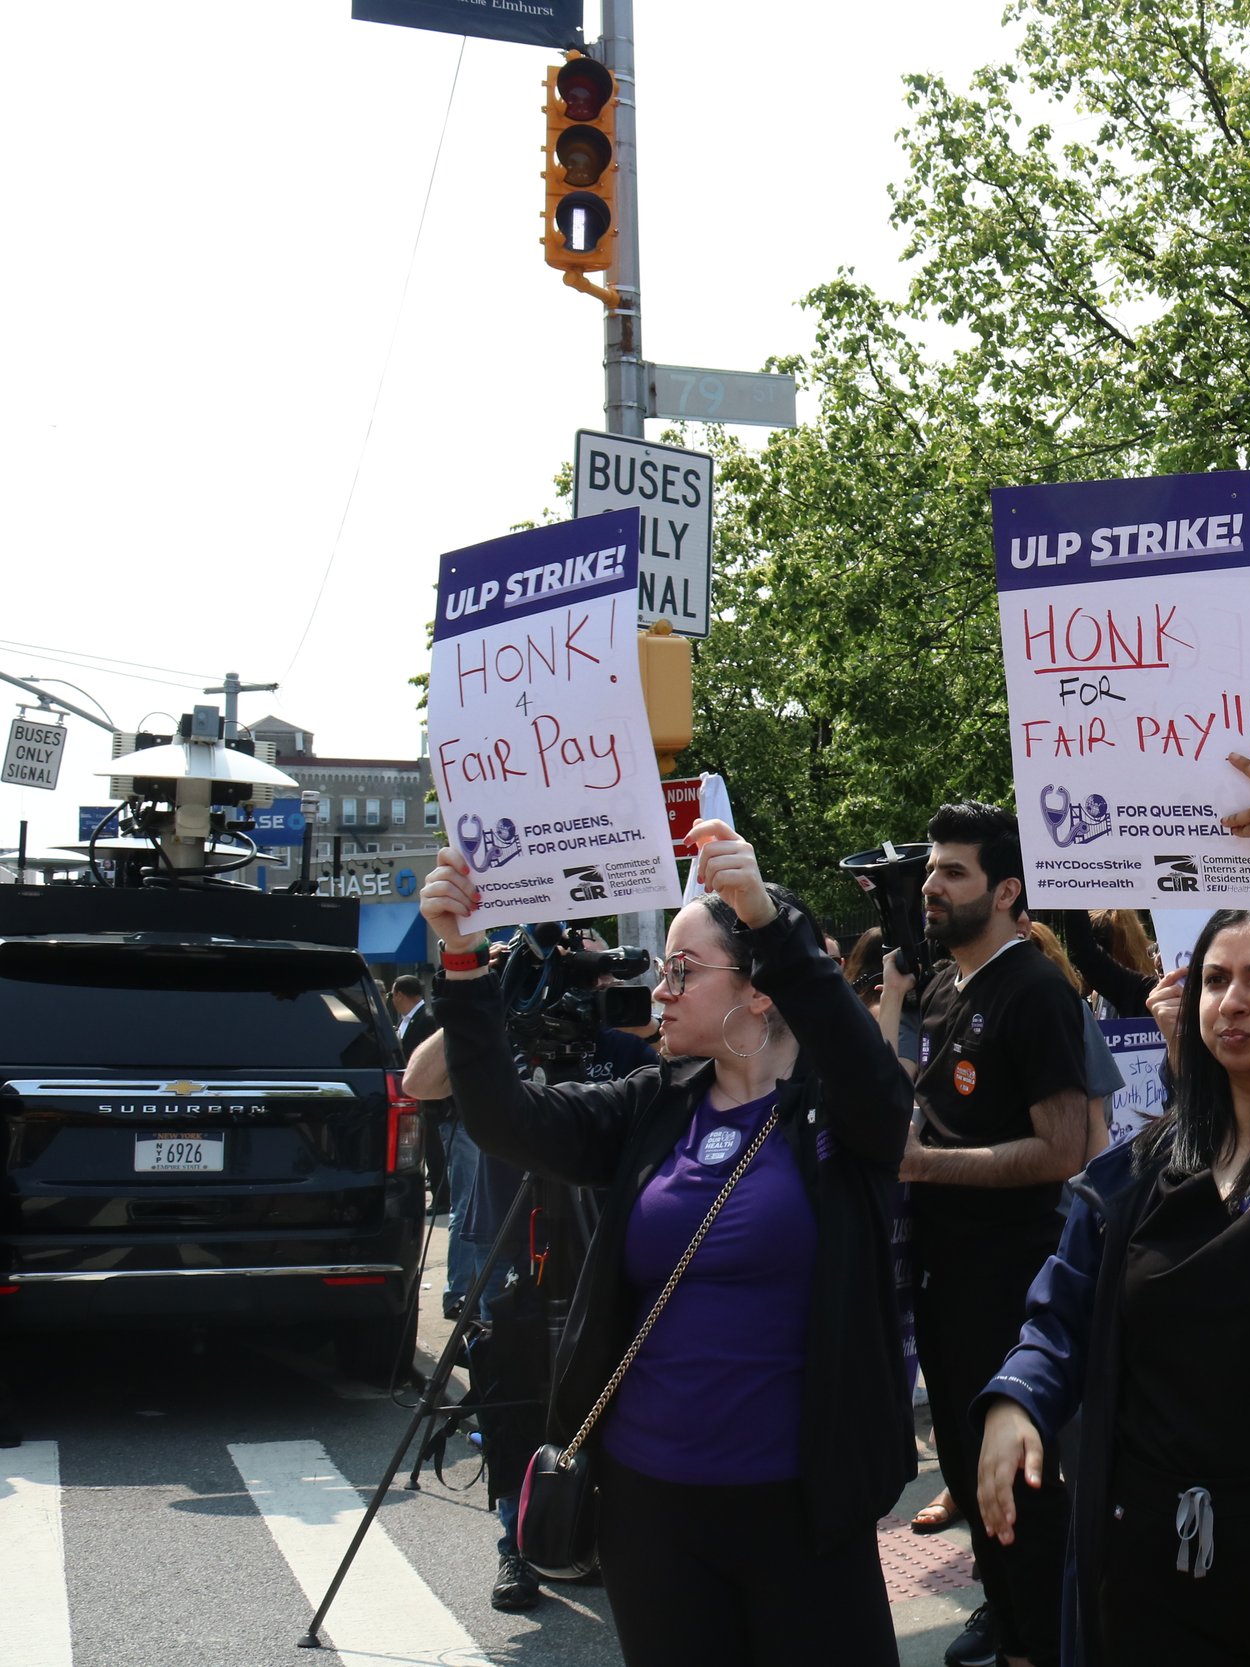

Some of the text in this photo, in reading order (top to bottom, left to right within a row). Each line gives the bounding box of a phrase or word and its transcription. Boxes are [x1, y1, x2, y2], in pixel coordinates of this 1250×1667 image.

[492, 0, 555, 16] Elmhurst
[670, 374, 777, 414] 79 ST
[589, 450, 701, 508] BUSES
[1010, 513, 1243, 569] ULP STRIKE!
[445, 545, 626, 620] ULP STRIKE!
[1024, 604, 1195, 667] HONK
[457, 599, 618, 708] HONK!
[1059, 675, 1126, 706] FOR
[516, 691, 533, 716] 4
[15, 726, 61, 746] BUSES
[1021, 717, 1115, 757] FAIR
[16, 745, 53, 763] ONLY
[531, 715, 621, 789] Pay
[7, 763, 52, 783] SIGNAL
[1117, 805, 1217, 818] FOR QUEENS,
[524, 815, 613, 837] FOR QUEENS,
[1119, 825, 1231, 836] FOR OUR HEAL
[528, 829, 645, 855] FOR OUR HEALTH.
[605, 856, 661, 871] Committee of
[607, 866, 656, 879] Interns and
[1035, 860, 1142, 871] #NYCDocsStrike
[1203, 865, 1236, 873] Interns
[317, 873, 391, 898] CHASE
[609, 877, 651, 888] Residents
[1037, 879, 1134, 889] #ForOurHealth
[1204, 874, 1250, 883] Residents
[476, 894, 551, 911] ForOurHealth
[1104, 1036, 1121, 1047] LP
[99, 1105, 267, 1114] SUBURBAN
[167, 1143, 202, 1163] 6926
[705, 1141, 734, 1150] HEALTH
